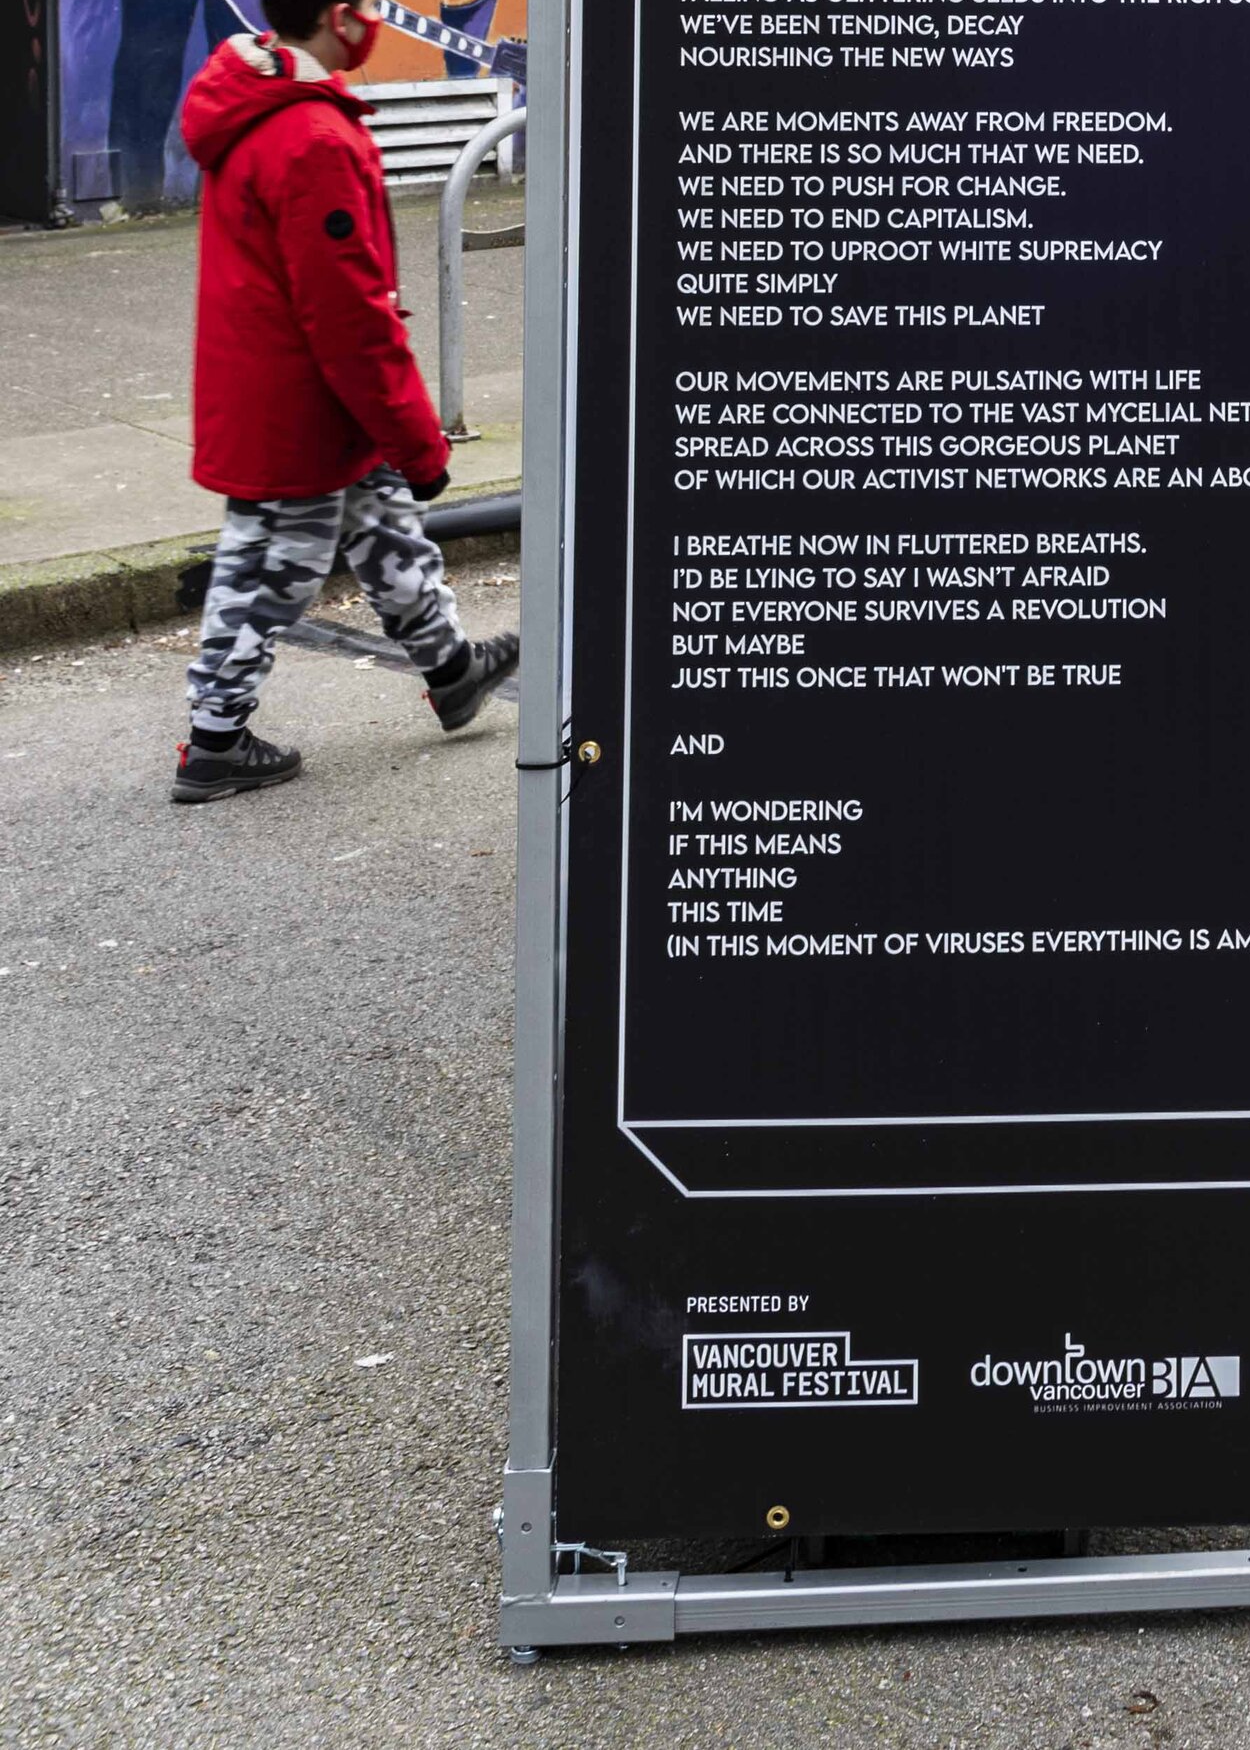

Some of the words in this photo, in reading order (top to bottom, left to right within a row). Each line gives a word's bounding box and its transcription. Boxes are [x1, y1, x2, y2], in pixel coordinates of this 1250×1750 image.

[678, 209, 713, 228] WE
[722, 209, 783, 228] NEED
[791, 209, 824, 228] TO
[832, 209, 880, 228] END
[888, 208, 1033, 228] CAPITALISM.
[677, 274, 748, 294] QUITE
[756, 274, 838, 293] SIMPLY
[676, 371, 728, 391] OUR
[737, 371, 889, 391] MOVEMENTS
[896, 371, 943, 391] ARE
[952, 370, 1082, 390] PULSATING
[1090, 370, 1147, 390] WITH
[1156, 370, 1201, 389] LIFE
[675, 437, 768, 457] SPREAD
[776, 436, 874, 456] ACROSS
[881, 436, 932, 456] THIS
[940, 435, 1081, 456] GORGEOUS
[1089, 435, 1179, 455] PLANET
[673, 602, 725, 622] NOT
[733, 601, 857, 621] EVERYONE
[865, 600, 980, 621] SURVIVES
[987, 600, 1005, 620] A
[1013, 598, 1166, 619] REVOLUTION
[672, 668, 731, 688] JUST
[738, 667, 789, 687] THIS
[797, 667, 866, 687] ONCE
[874, 666, 934, 687] THAT
[942, 665, 1020, 686] WON'T
[1028, 665, 1055, 685] BE
[1062, 665, 1121, 685] TRUE
[670, 801, 702, 821] I'M
[711, 800, 863, 821] WONDERING
[667, 935, 699, 958] (IN
[707, 935, 759, 956] THIS
[767, 934, 877, 955] MOMENT
[884, 933, 918, 954] OF
[926, 932, 1024, 953] VIRUSES
[1033, 929, 1182, 952] EVERYTHING
[1190, 929, 1210, 950] IS
[686, 1296, 781, 1313] PRESENTED
[788, 1295, 809, 1312] BY
[692, 1343, 838, 1369] VANCOUVER
[970, 1332, 1146, 1387] downtown
[1152, 1356, 1241, 1398] BIA
[692, 1373, 775, 1398] MURAL
[783, 1370, 907, 1397] FESTIVAL
[1029, 1382, 1146, 1401] vancouver
[1033, 1404, 1080, 1413] BUSINESS
[1083, 1402, 1153, 1412] IMPROVEMENT
[1157, 1400, 1223, 1410] ASSOCIATION
